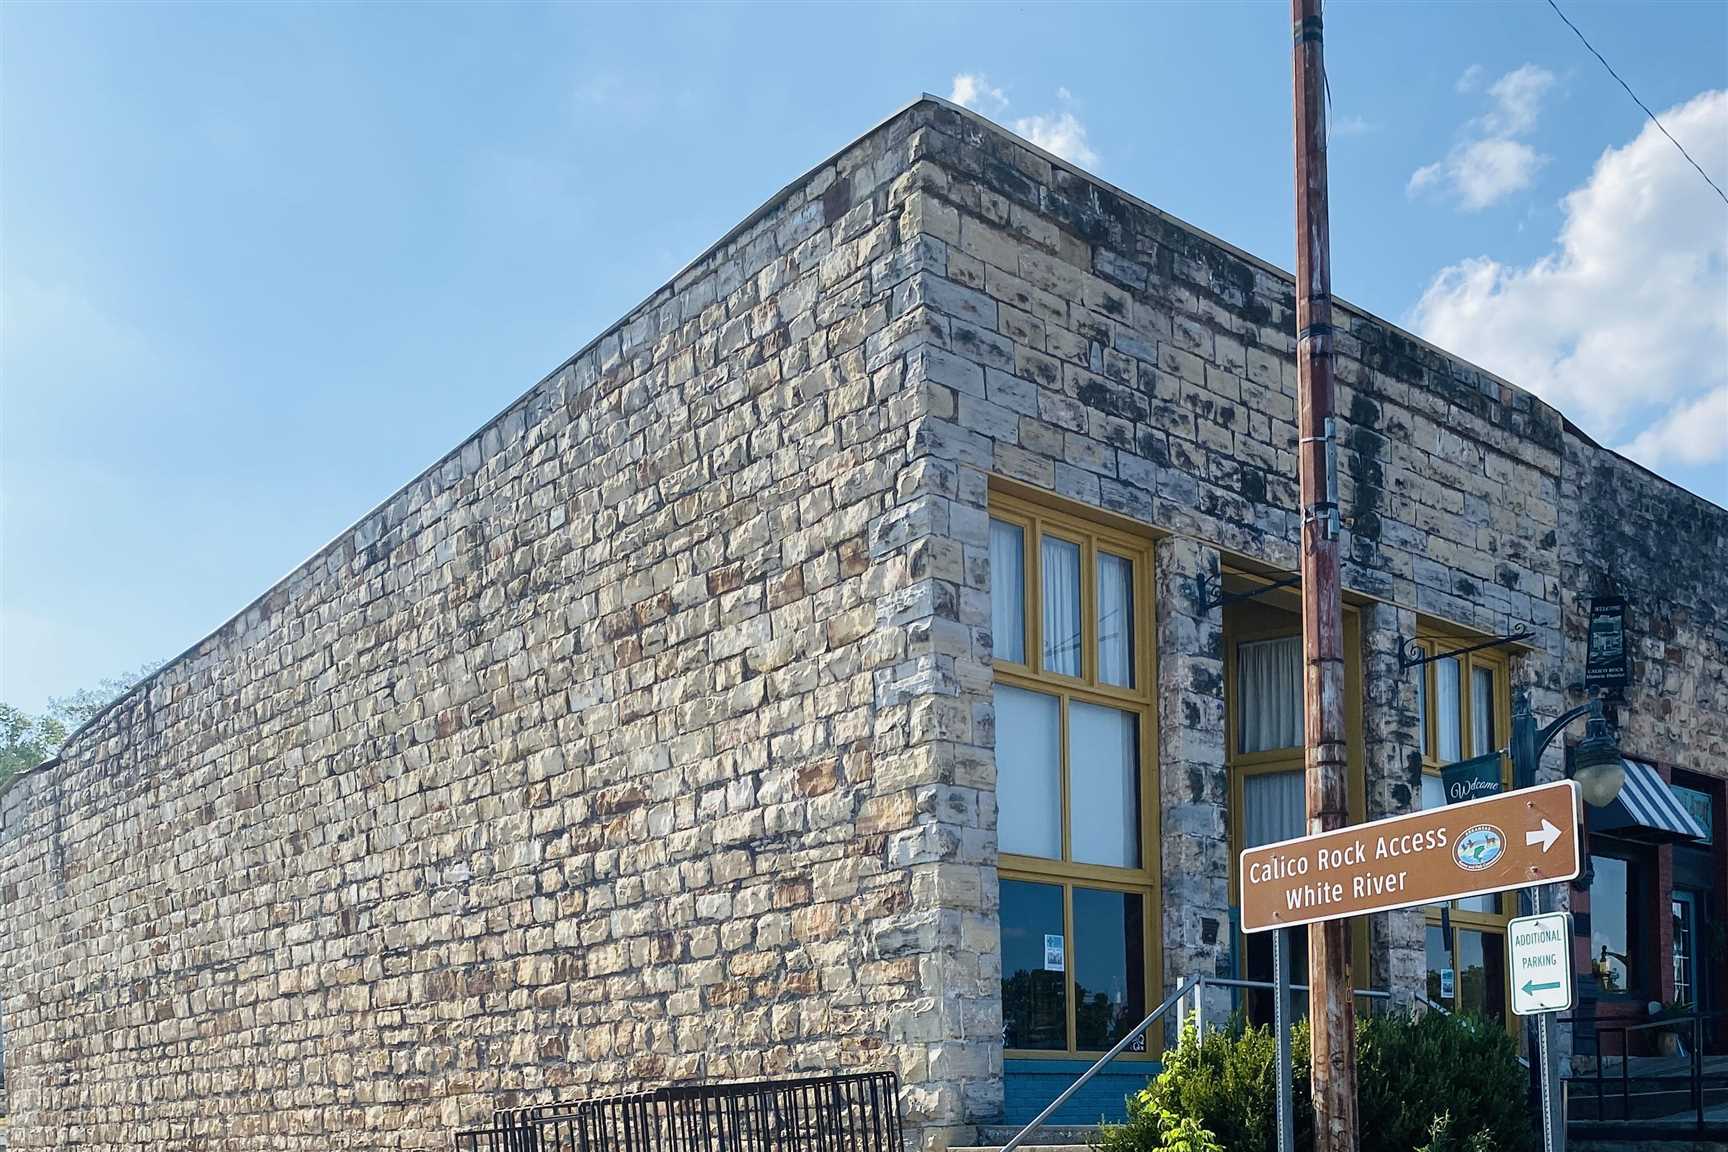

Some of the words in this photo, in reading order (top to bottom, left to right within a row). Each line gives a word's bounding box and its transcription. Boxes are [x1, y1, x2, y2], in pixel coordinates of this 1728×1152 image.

[1450, 777, 1499, 798] Welcome
[1249, 855, 1308, 884] Calico
[1318, 840, 1366, 871] Rock
[1375, 827, 1447, 860] Access
[1286, 882, 1343, 910] White
[1353, 871, 1407, 898] River
[1515, 929, 1562, 946] ADDITIONAL
[1522, 953, 1557, 969] PARKING
